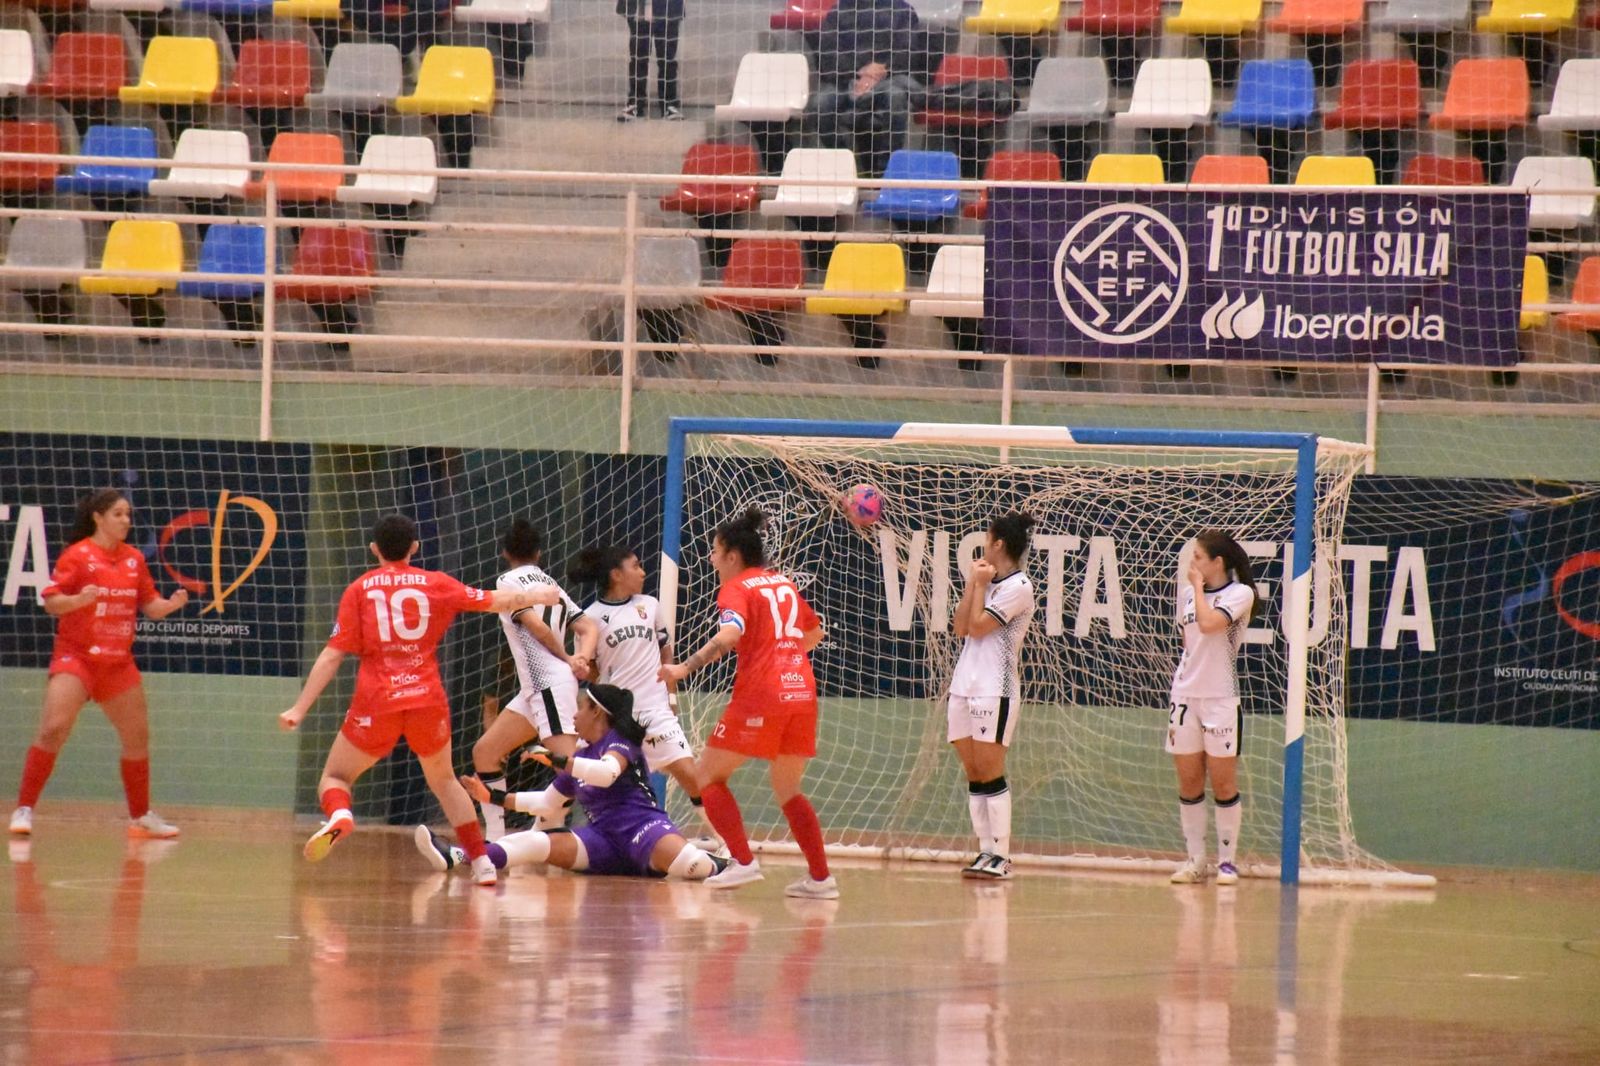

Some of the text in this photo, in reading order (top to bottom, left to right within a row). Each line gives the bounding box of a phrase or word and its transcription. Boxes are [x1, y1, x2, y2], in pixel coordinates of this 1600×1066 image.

[1250, 202, 1451, 226] DIVISIÓN
[1245, 223, 1450, 277] FÚTBOL SALA
[1274, 304, 1445, 342] Iberdrola
[367, 588, 431, 642] 10
[759, 585, 804, 640] 12
[202, 624, 250, 636] DEPORTES
[605, 624, 653, 649] CEUTA
[1494, 667, 1548, 680] INSTITUTO
[1169, 702, 1188, 726] 27
[713, 722, 726, 738] 12
